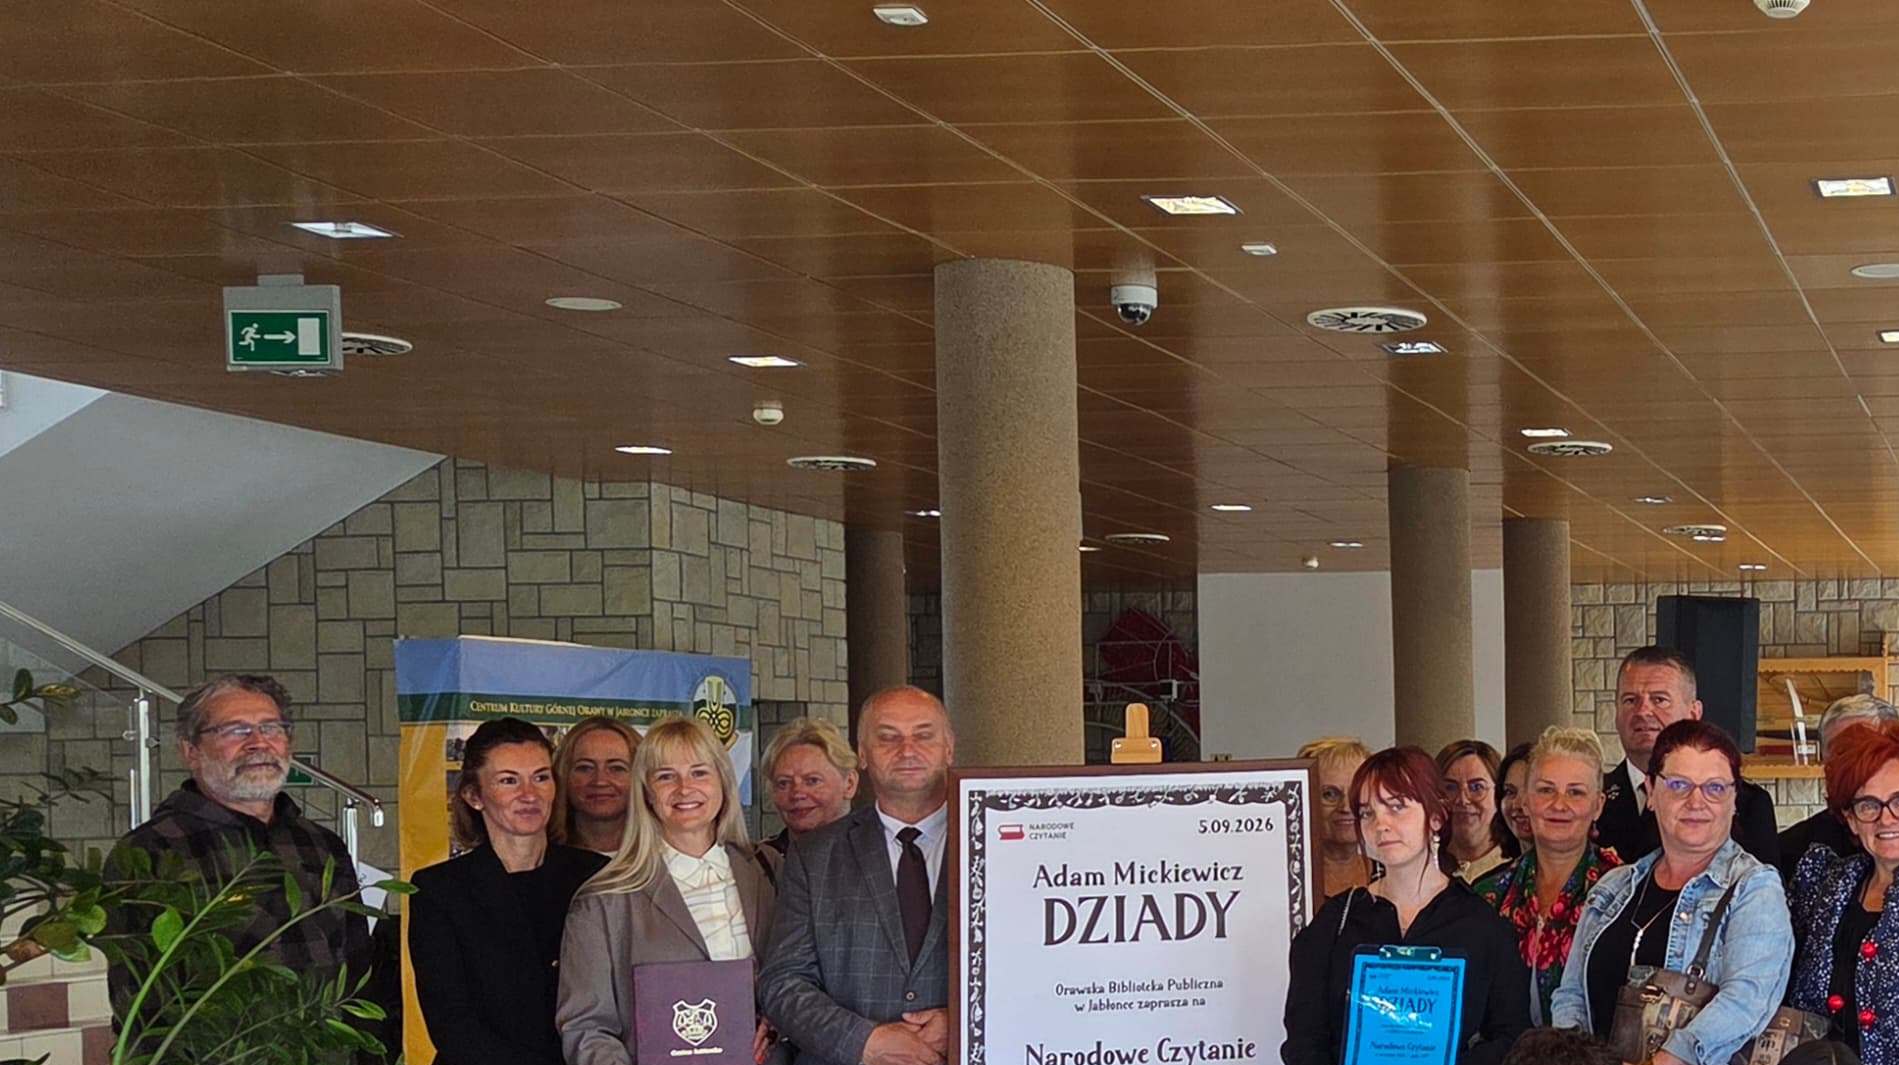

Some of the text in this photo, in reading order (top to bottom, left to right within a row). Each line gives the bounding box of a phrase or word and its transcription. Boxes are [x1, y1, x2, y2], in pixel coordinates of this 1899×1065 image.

[470, 700, 508, 712] CENTRUM
[545, 702, 576, 716] GÓRNEJ
[1029, 822, 1075, 831] NARODOWE
[1198, 817, 1274, 834] 5.09.2026
[1029, 831, 1067, 840] CZYTANIE
[1032, 860, 1244, 888] Adam Mickiewicz
[1043, 890, 1241, 946] DZIADY
[1055, 977, 1223, 996] Orawska Biblioteka Publiczna
[1075, 997, 1206, 1013] w Jabłonce zaprasza na
